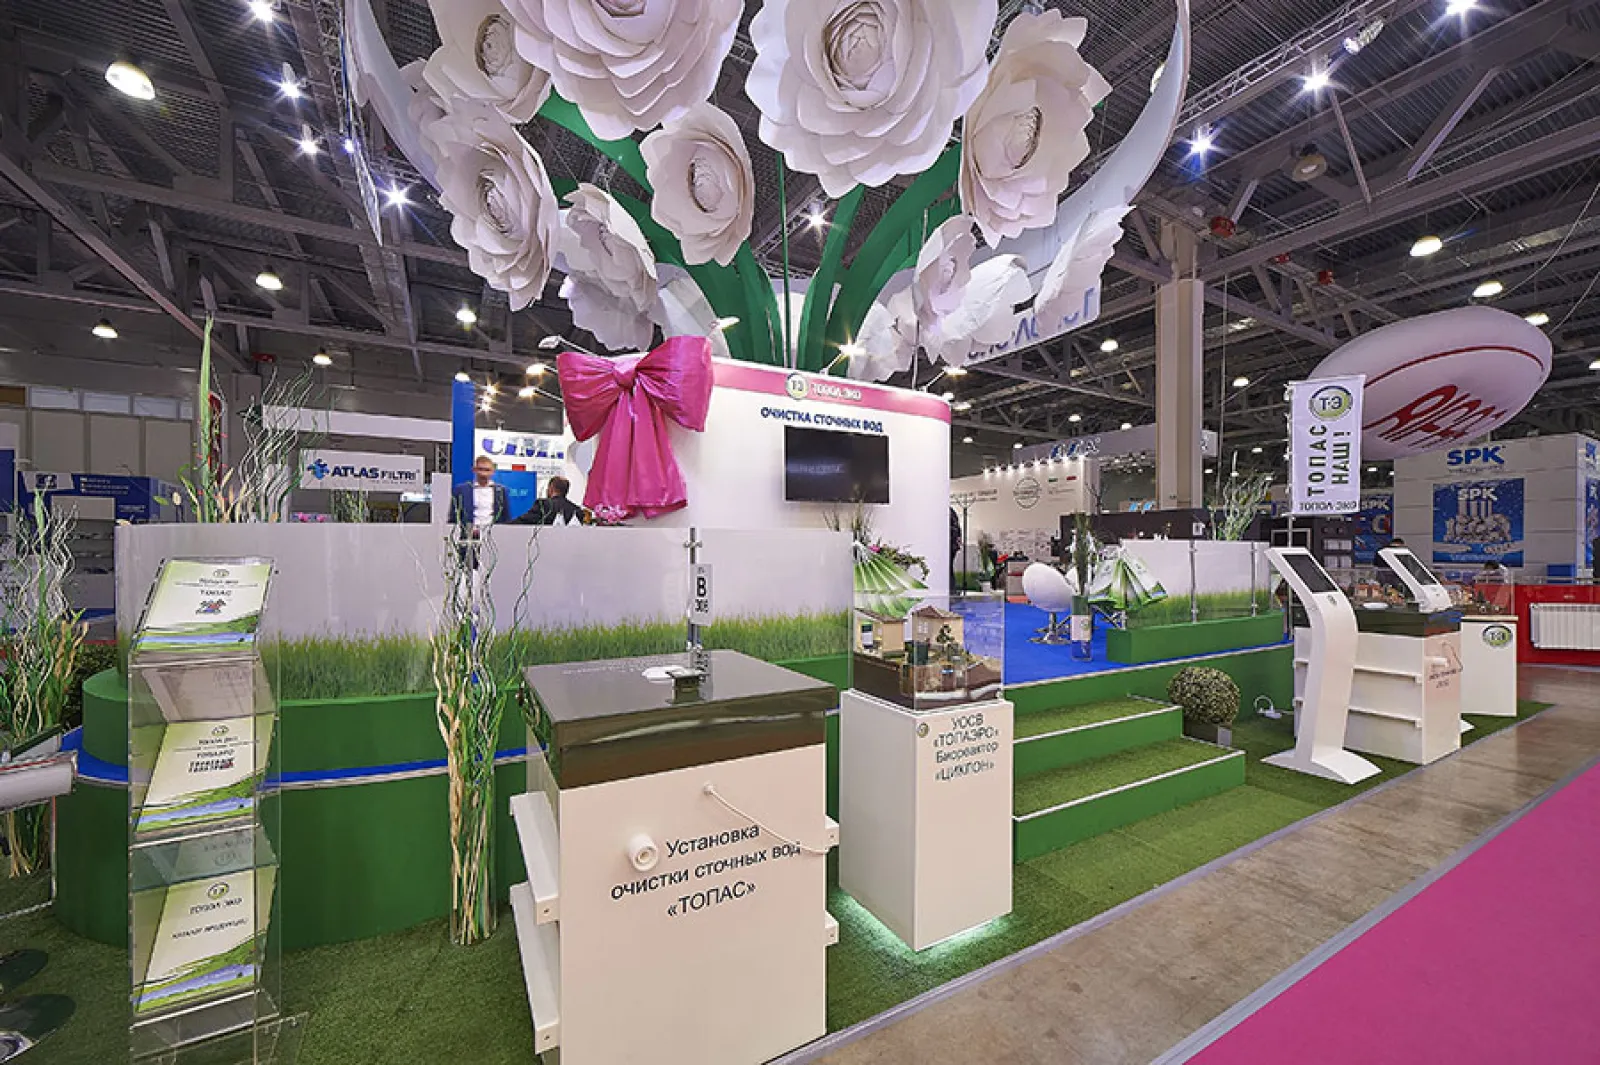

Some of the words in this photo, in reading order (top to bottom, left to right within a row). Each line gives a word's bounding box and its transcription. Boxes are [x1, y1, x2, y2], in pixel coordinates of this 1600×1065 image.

[760, 406, 811, 423] ОЧИСТКА
[813, 413, 862, 430] СТОЧНЫХ
[863, 420, 884, 433] ВОД
[1307, 424, 1328, 497] ТОПАС
[1331, 431, 1351, 485] НАШ!
[1446, 446, 1505, 465] SPK
[331, 465, 380, 479] ATLAS
[1457, 486, 1498, 501] SPK
[951, 712, 984, 731] УОСВ
[936, 741, 999, 764] Биореактор
[666, 823, 761, 858] Установка
[610, 868, 690, 901] очистки
[694, 850, 768, 880] сточных
[772, 841, 801, 860] вод
[666, 880, 756, 918] «ТОПАС»
